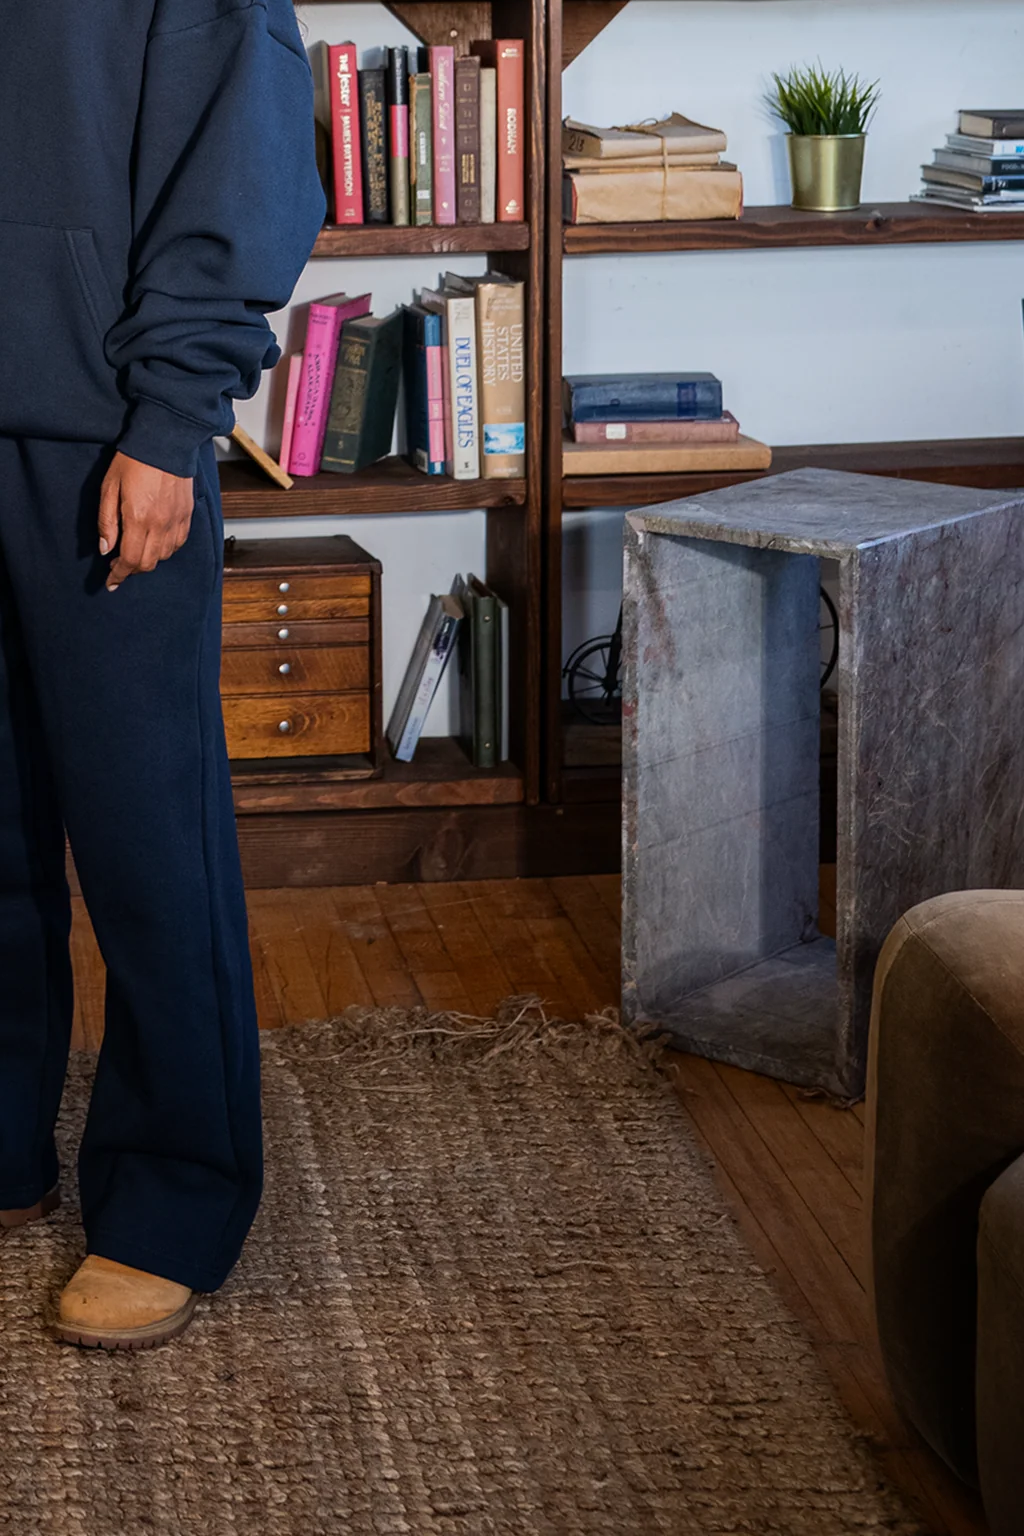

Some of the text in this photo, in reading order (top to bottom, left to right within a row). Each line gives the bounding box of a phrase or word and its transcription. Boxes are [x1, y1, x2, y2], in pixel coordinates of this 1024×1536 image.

[337, 53, 352, 107] THE Jester
[340, 115, 352, 142] JAMES
[506, 107, 517, 155] RODHAM
[342, 142, 354, 197] PATTERSON
[454, 336, 471, 374] DUEL
[482, 321, 497, 386] HISTORY
[496, 326, 510, 381] STATES
[509, 323, 524, 383] UNITED
[456, 375, 472, 396] OF
[456, 396, 474, 449] EAGLES
